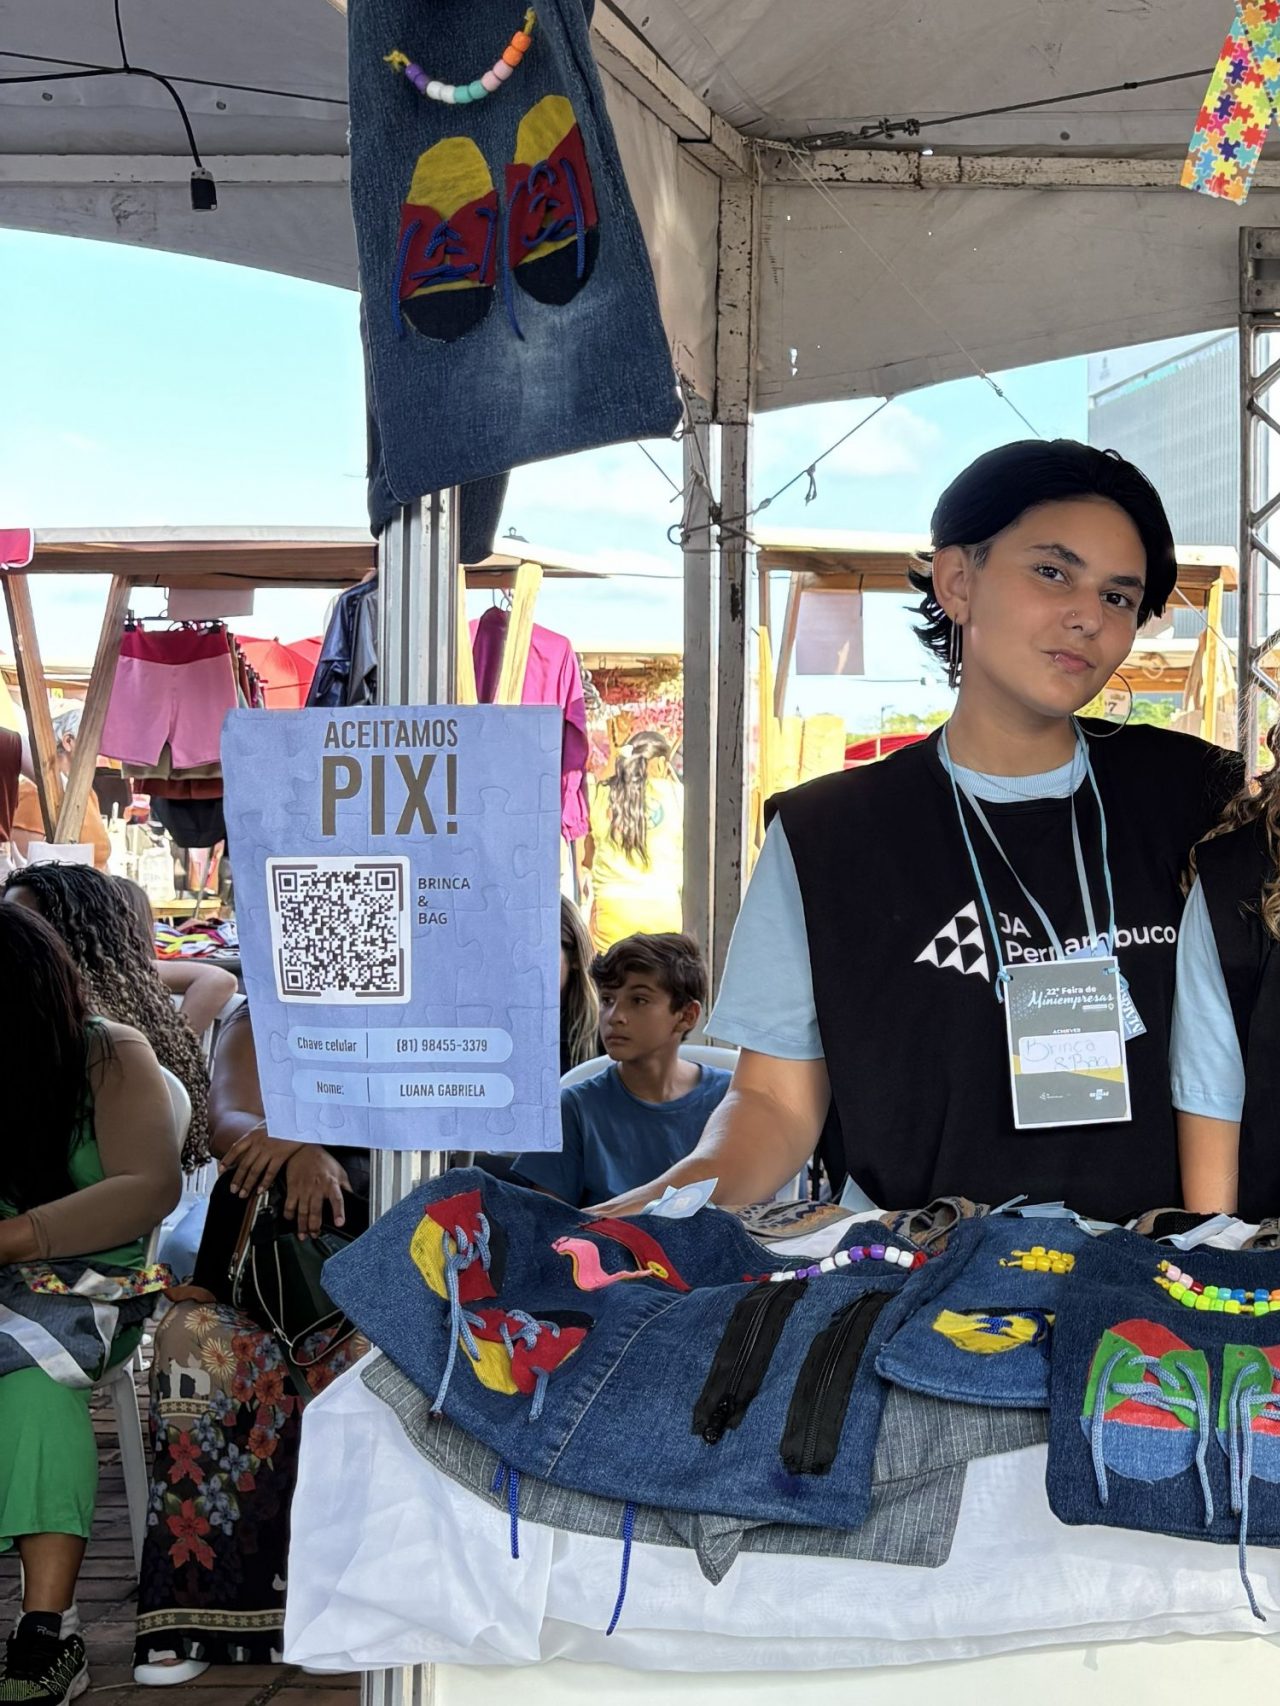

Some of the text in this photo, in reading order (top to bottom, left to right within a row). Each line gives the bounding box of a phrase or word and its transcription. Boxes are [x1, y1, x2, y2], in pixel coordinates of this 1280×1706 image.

[324, 719, 459, 749] ACEITAMOS
[321, 754, 459, 836] PIX!
[418, 877, 470, 891] BRINCA
[418, 895, 429, 908] &
[418, 912, 448, 926] BAG
[999, 912, 1032, 938] JA
[1027, 990, 1115, 1010] Miniempresas
[297, 1036, 488, 1053] Chave celular (81) 98455-3379
[316, 1081, 486, 1097] Nome: LUANA GABRIELA
